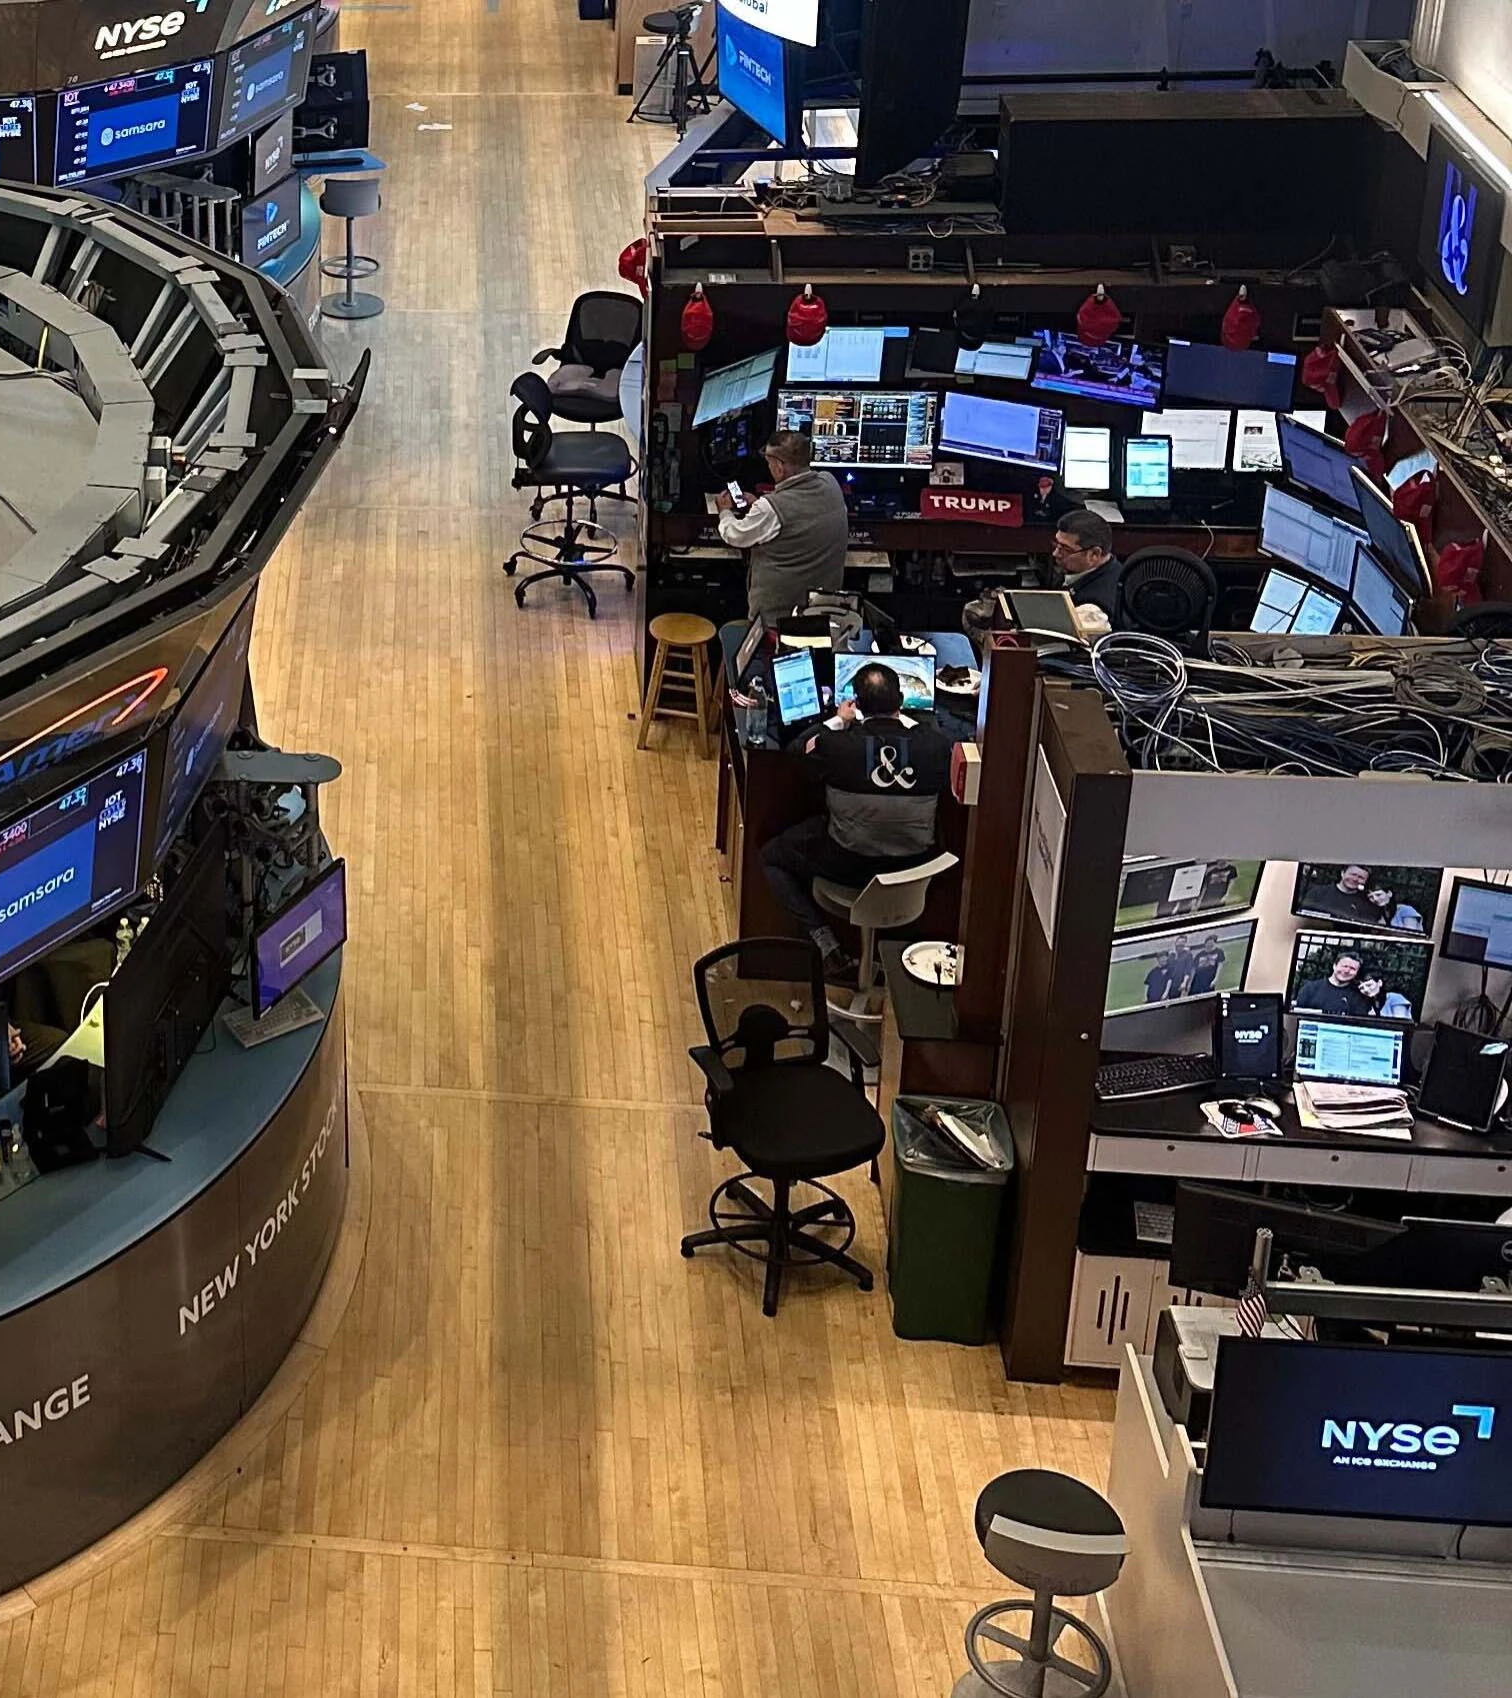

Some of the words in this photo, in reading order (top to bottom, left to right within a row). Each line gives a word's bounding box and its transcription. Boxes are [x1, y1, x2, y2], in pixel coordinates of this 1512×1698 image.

[115, 119, 166, 140] samsara
[929, 495, 1012, 513] TRUMP
[105, 790, 123, 808] IOT
[99, 808, 125, 831] NYSE
[179, 1254, 240, 1336] NEW
[245, 1179, 300, 1266] YORK
